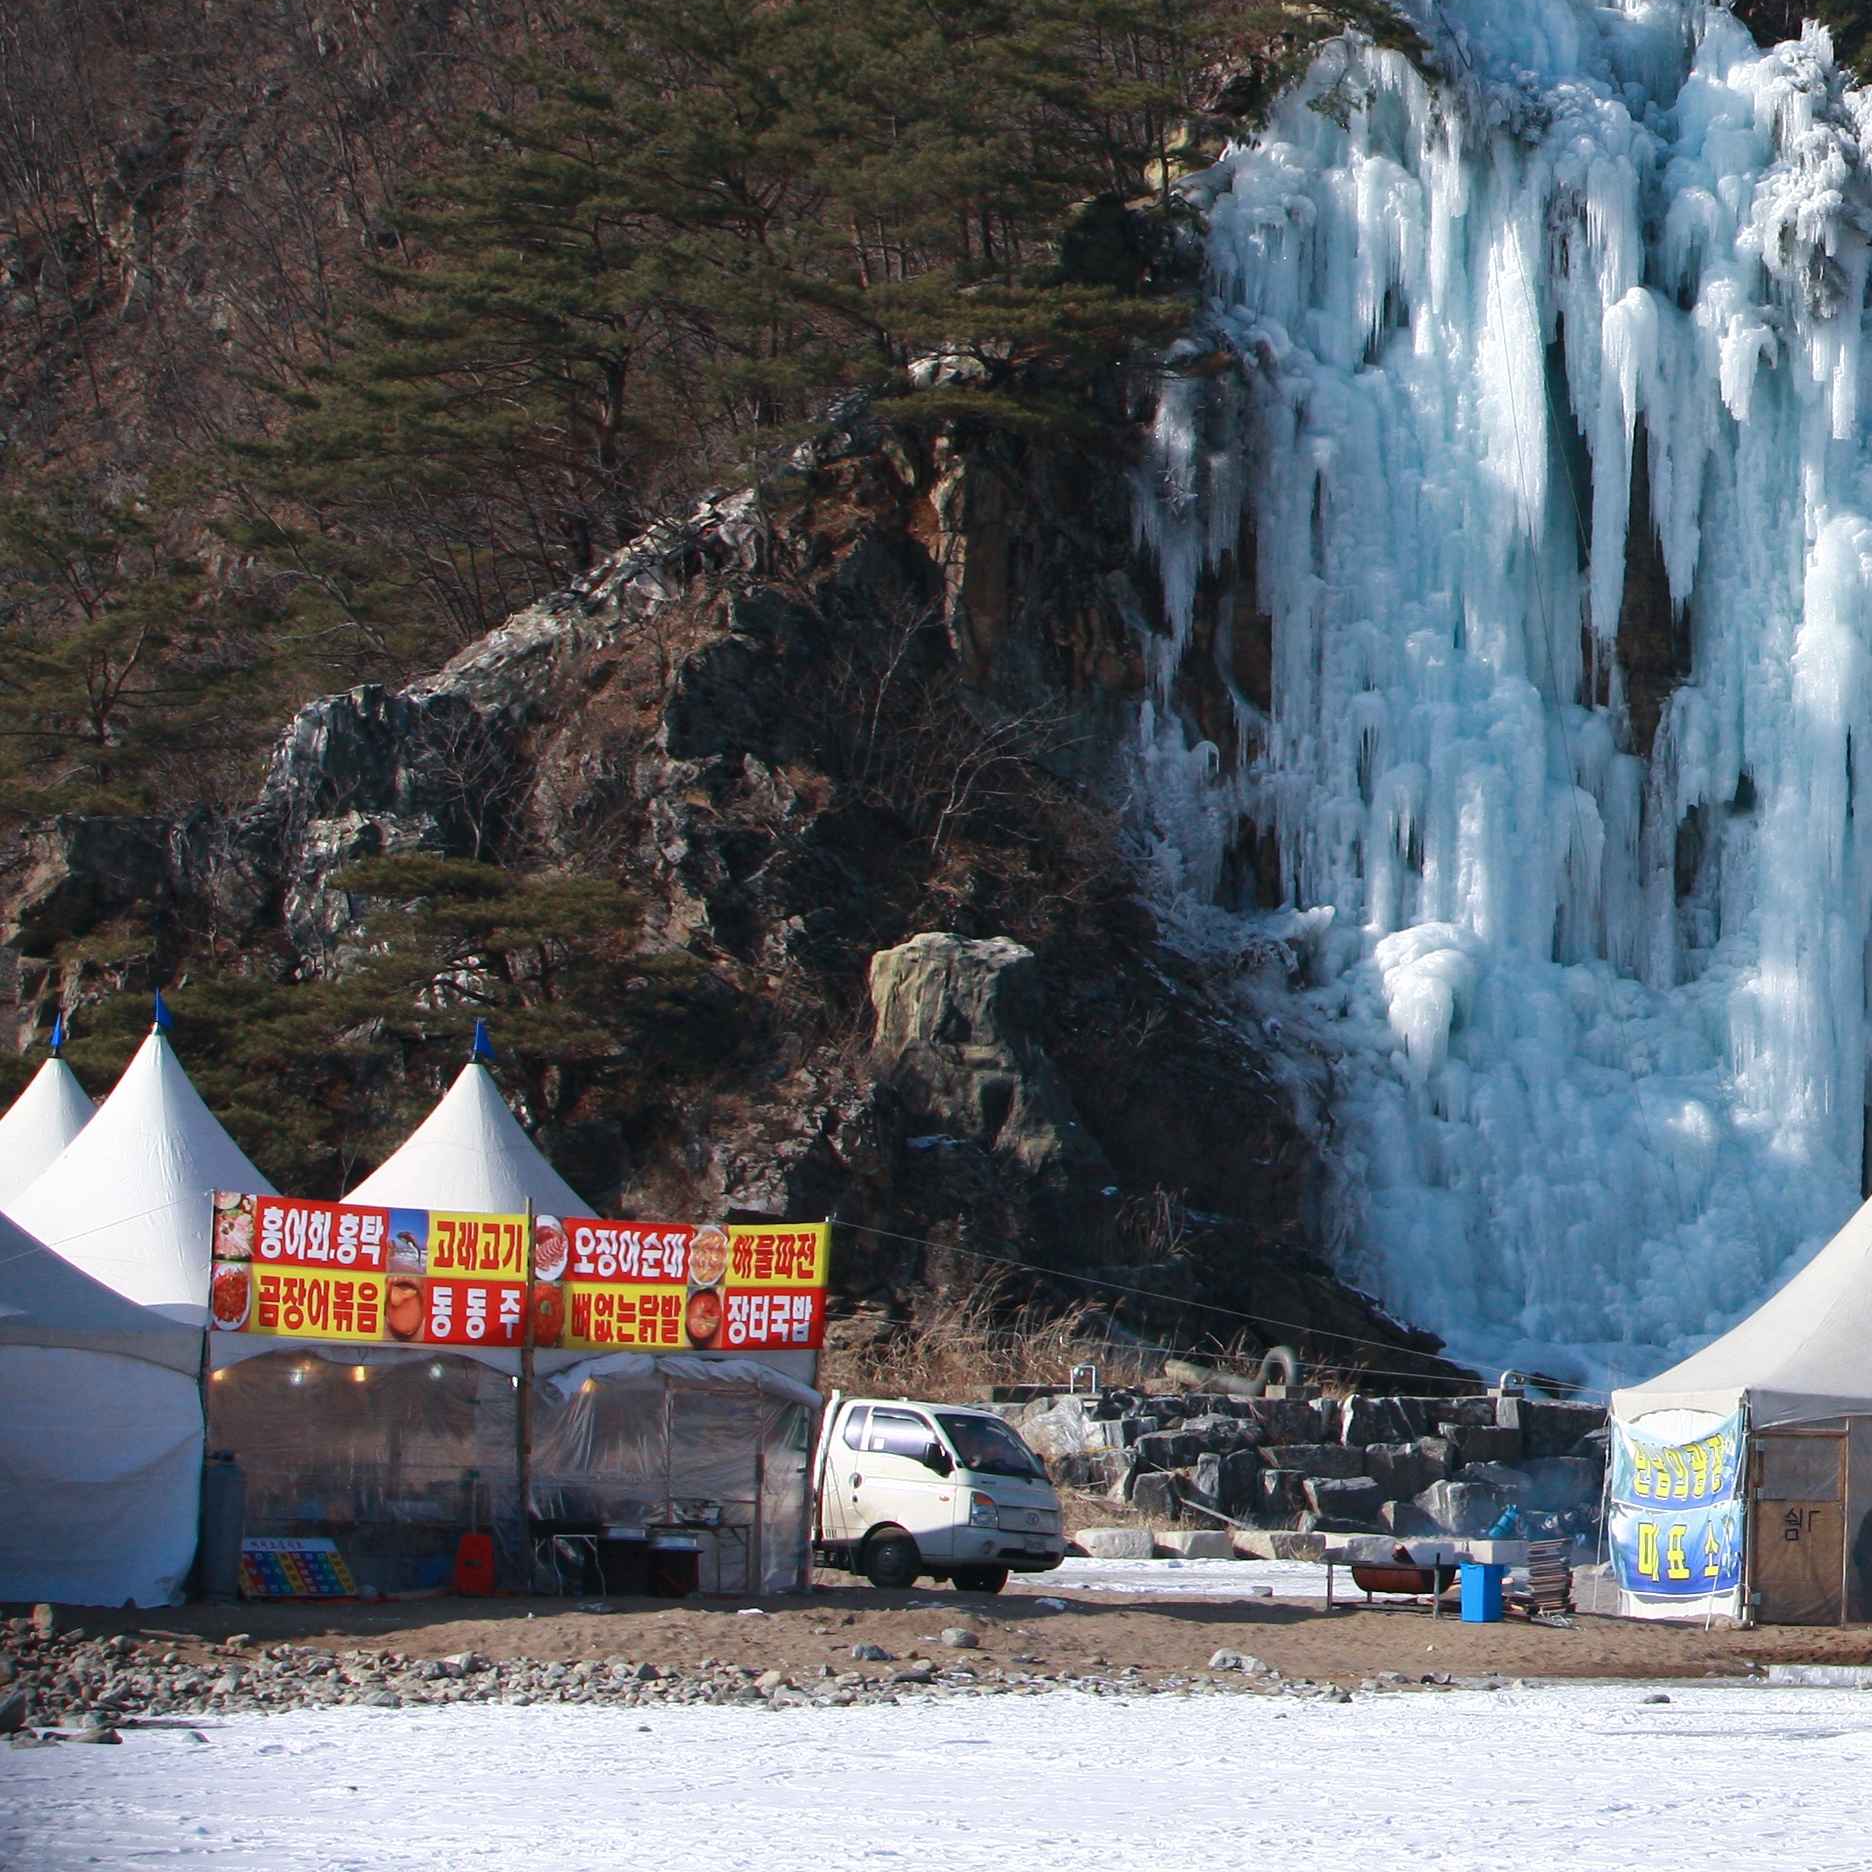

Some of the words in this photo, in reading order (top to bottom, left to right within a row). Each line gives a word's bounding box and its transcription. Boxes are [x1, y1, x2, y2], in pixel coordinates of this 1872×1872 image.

[433, 1220, 523, 1273] 고래고기
[574, 1227, 686, 1278] 오징어순대
[732, 1232, 816, 1280] 해물파전
[258, 1275, 378, 1333] 곰장어볶음
[571, 1293, 681, 1344] 뼈없는닭발
[727, 1295, 813, 1344] 장터국밥
